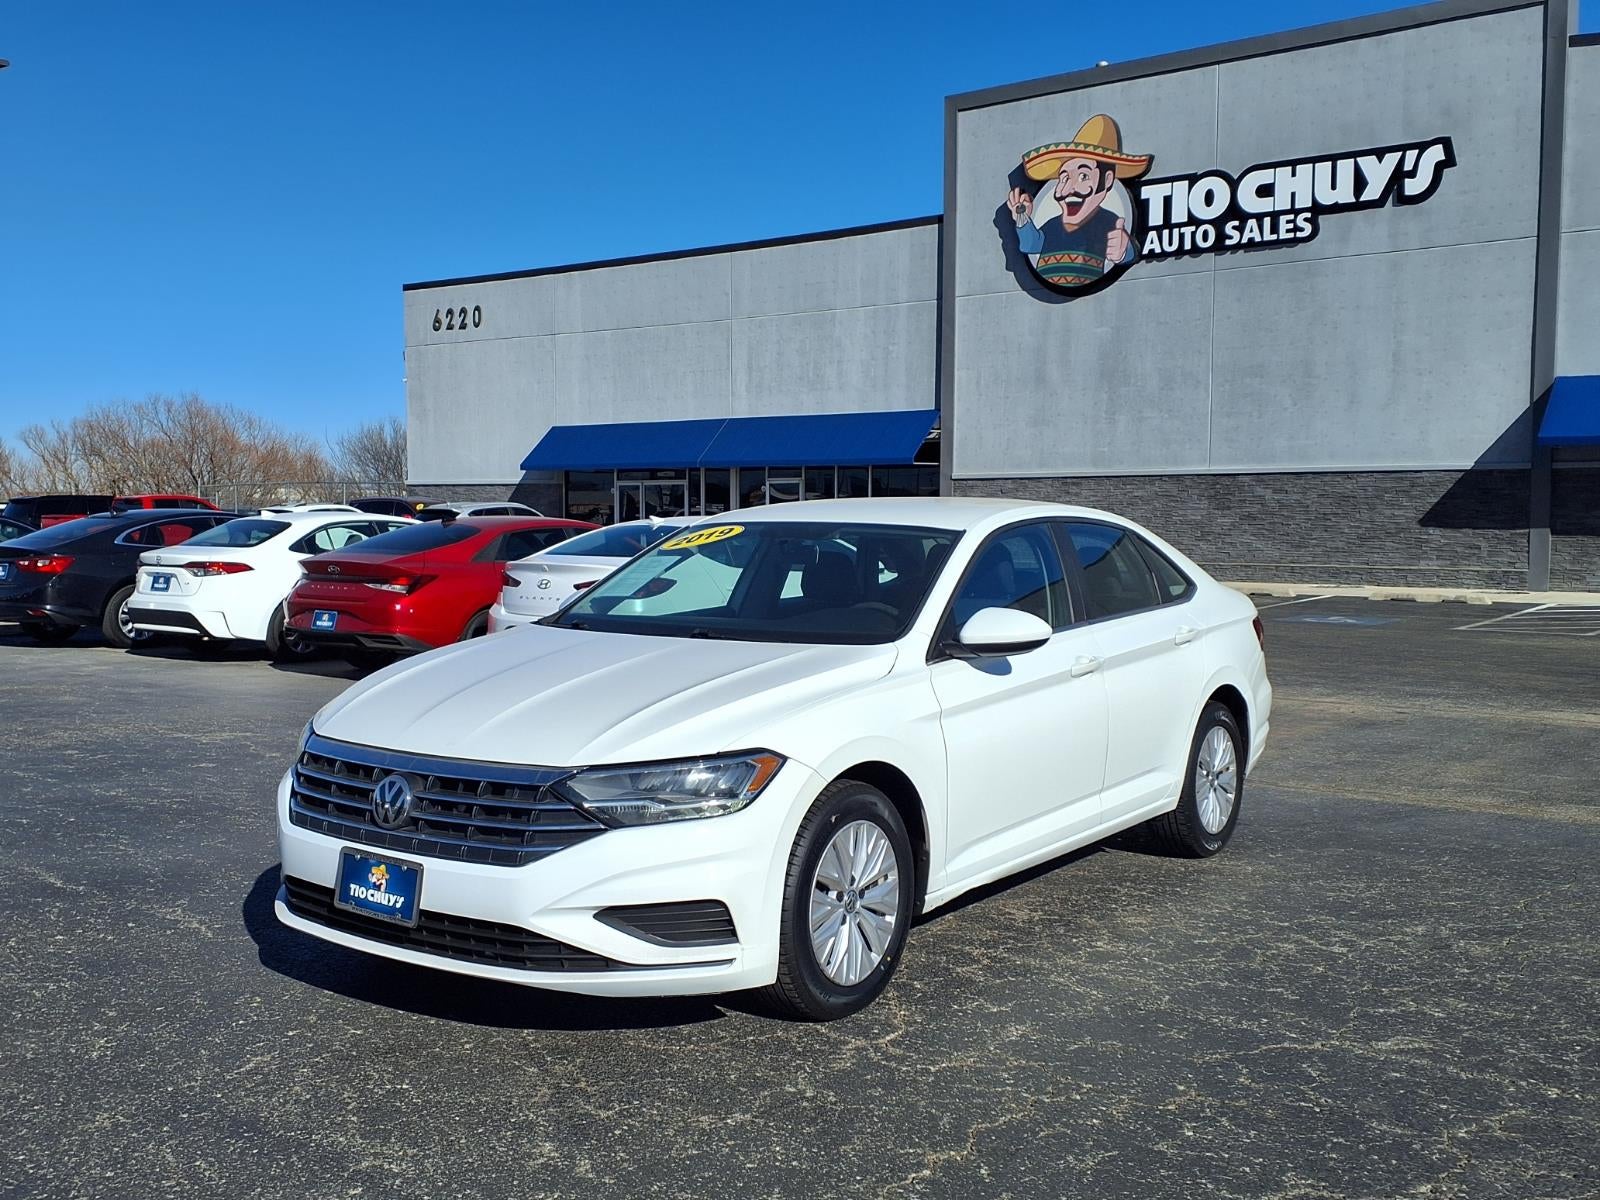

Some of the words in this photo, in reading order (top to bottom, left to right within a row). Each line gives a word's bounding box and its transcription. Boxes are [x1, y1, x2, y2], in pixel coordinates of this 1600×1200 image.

[1140, 176, 1231, 227] TIO
[1237, 144, 1446, 214] CHUY'S
[1142, 223, 1216, 254] AUTO
[1224, 211, 1313, 246] SALES
[432, 304, 482, 332] 6220
[669, 527, 735, 548] 2019
[349, 883, 367, 899] TIO
[366, 889, 405, 909] CHUY'S
